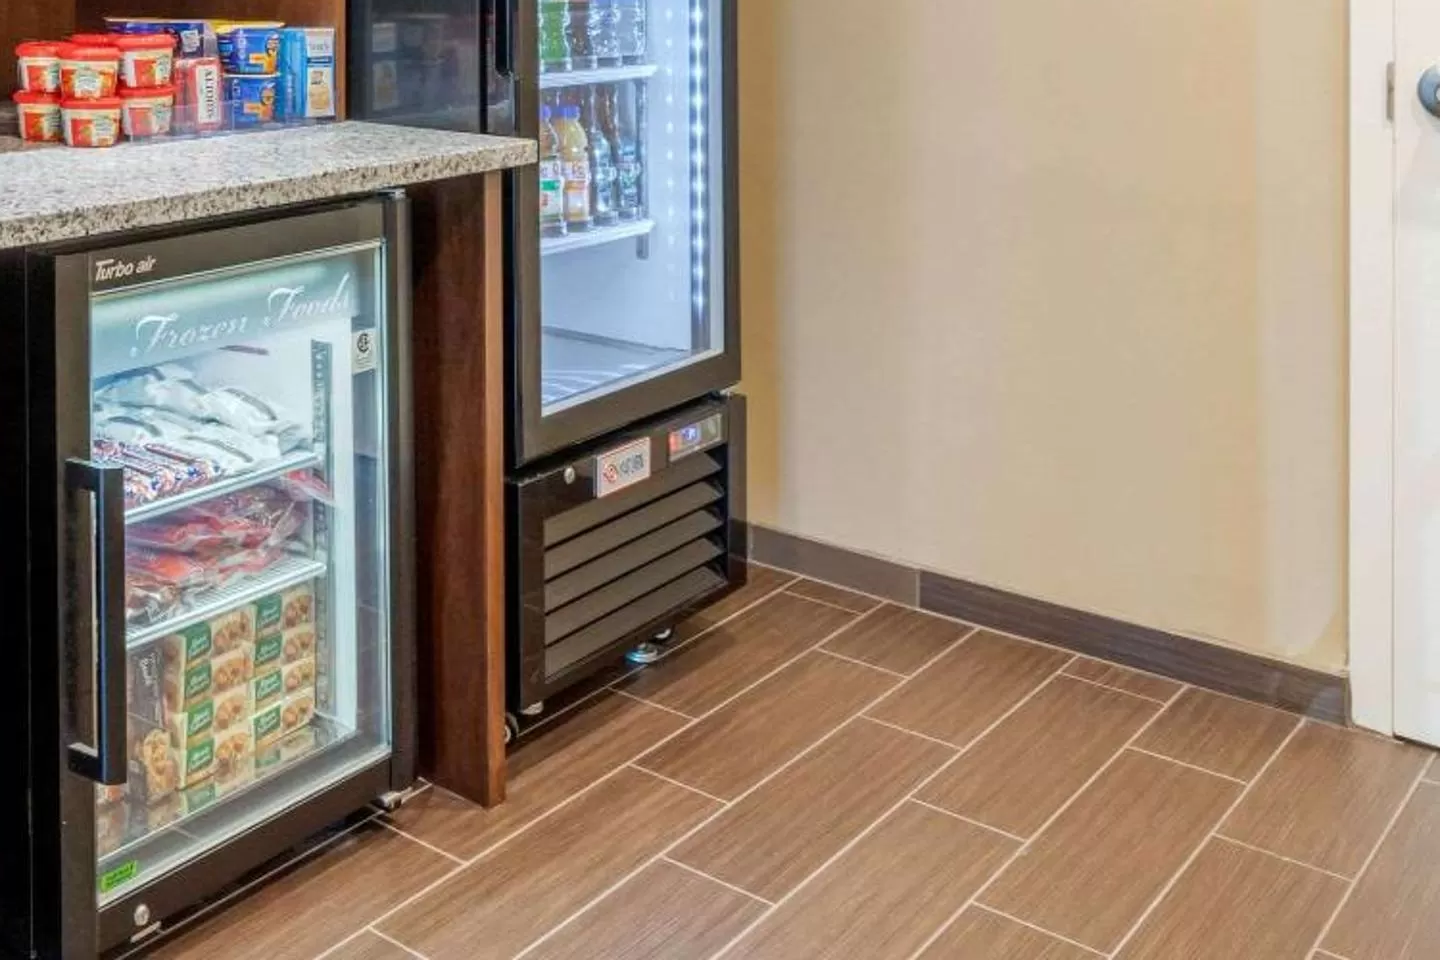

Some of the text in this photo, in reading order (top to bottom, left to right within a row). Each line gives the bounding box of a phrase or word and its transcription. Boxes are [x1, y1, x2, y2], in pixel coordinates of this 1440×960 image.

[94, 255, 157, 282] Turbo air
[128, 312, 249, 358] Frozen
